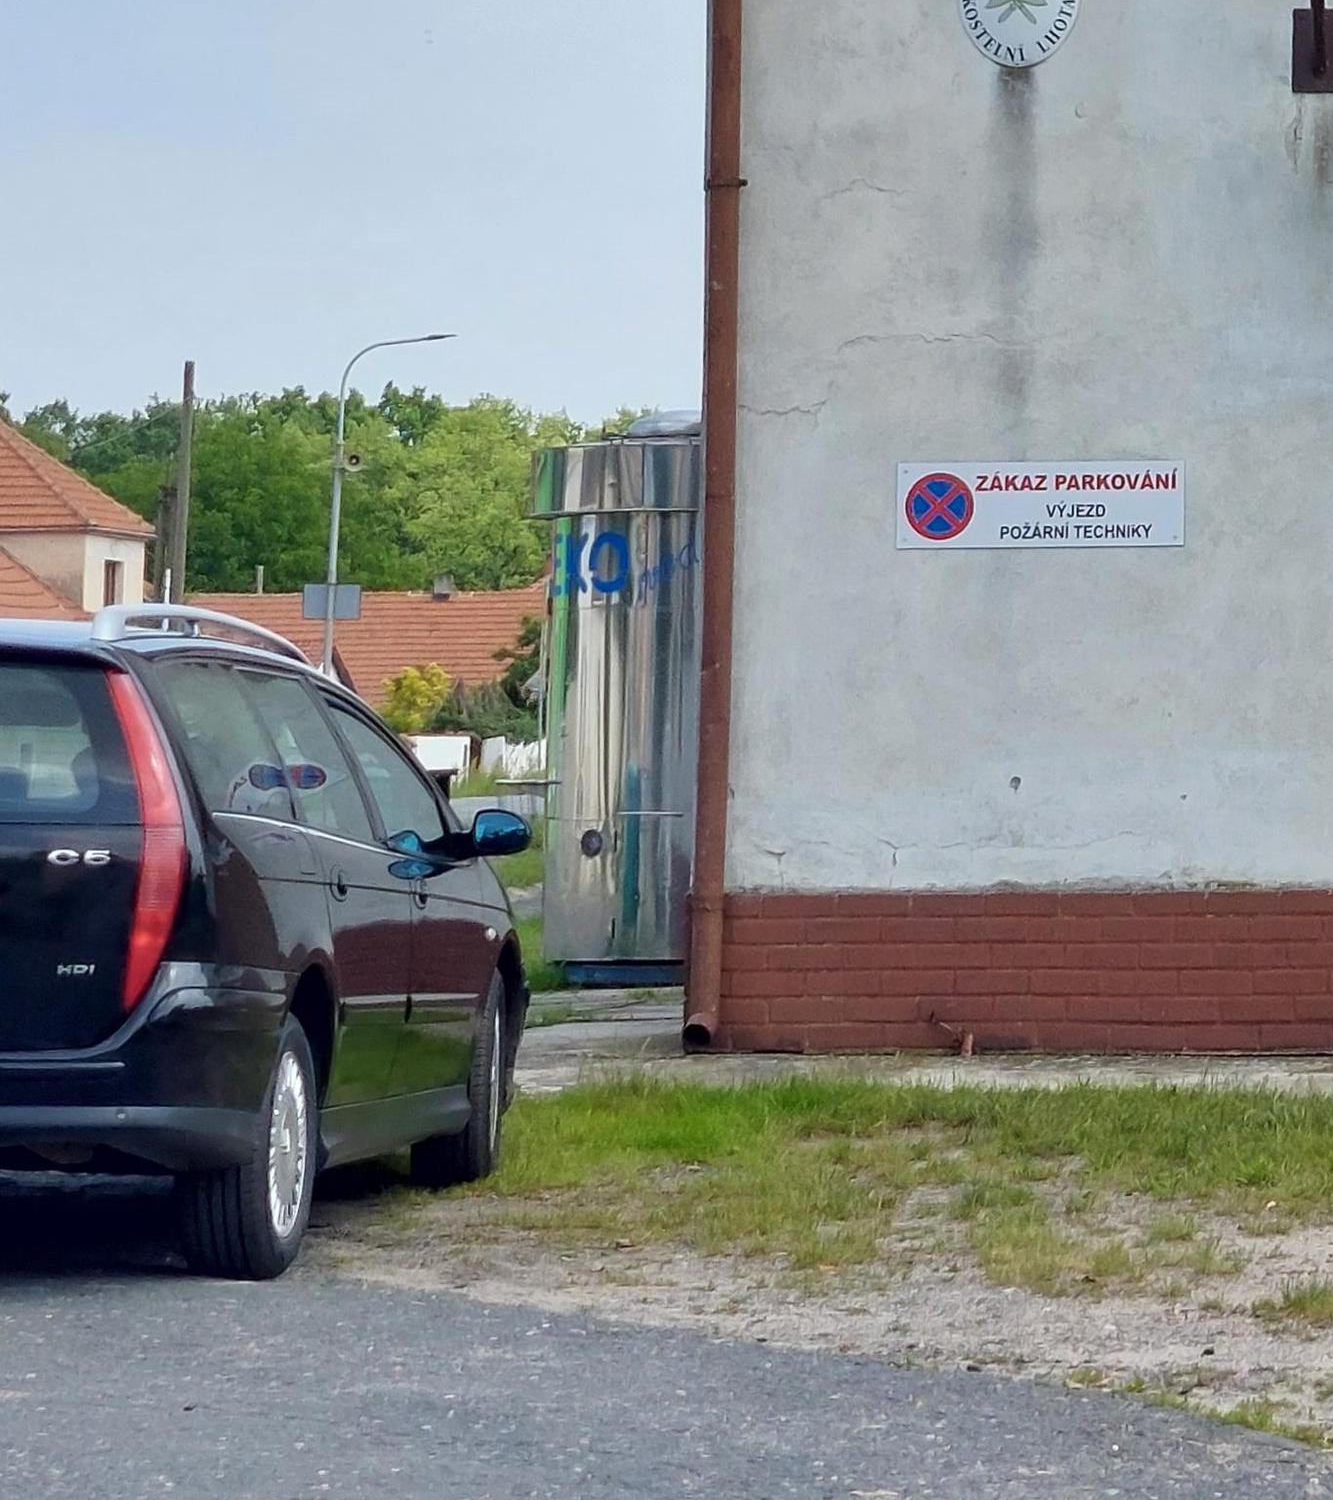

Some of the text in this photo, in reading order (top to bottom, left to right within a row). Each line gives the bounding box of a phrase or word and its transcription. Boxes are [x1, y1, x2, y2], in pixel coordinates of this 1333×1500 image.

[975, 468, 1177, 492] ZÁKAZ PARKOVÁNÍ
[1046, 500, 1106, 518] VÝJEZD
[1000, 521, 1152, 540] POŽÁRNÍ TECHNIKY
[47, 849, 111, 865] C5
